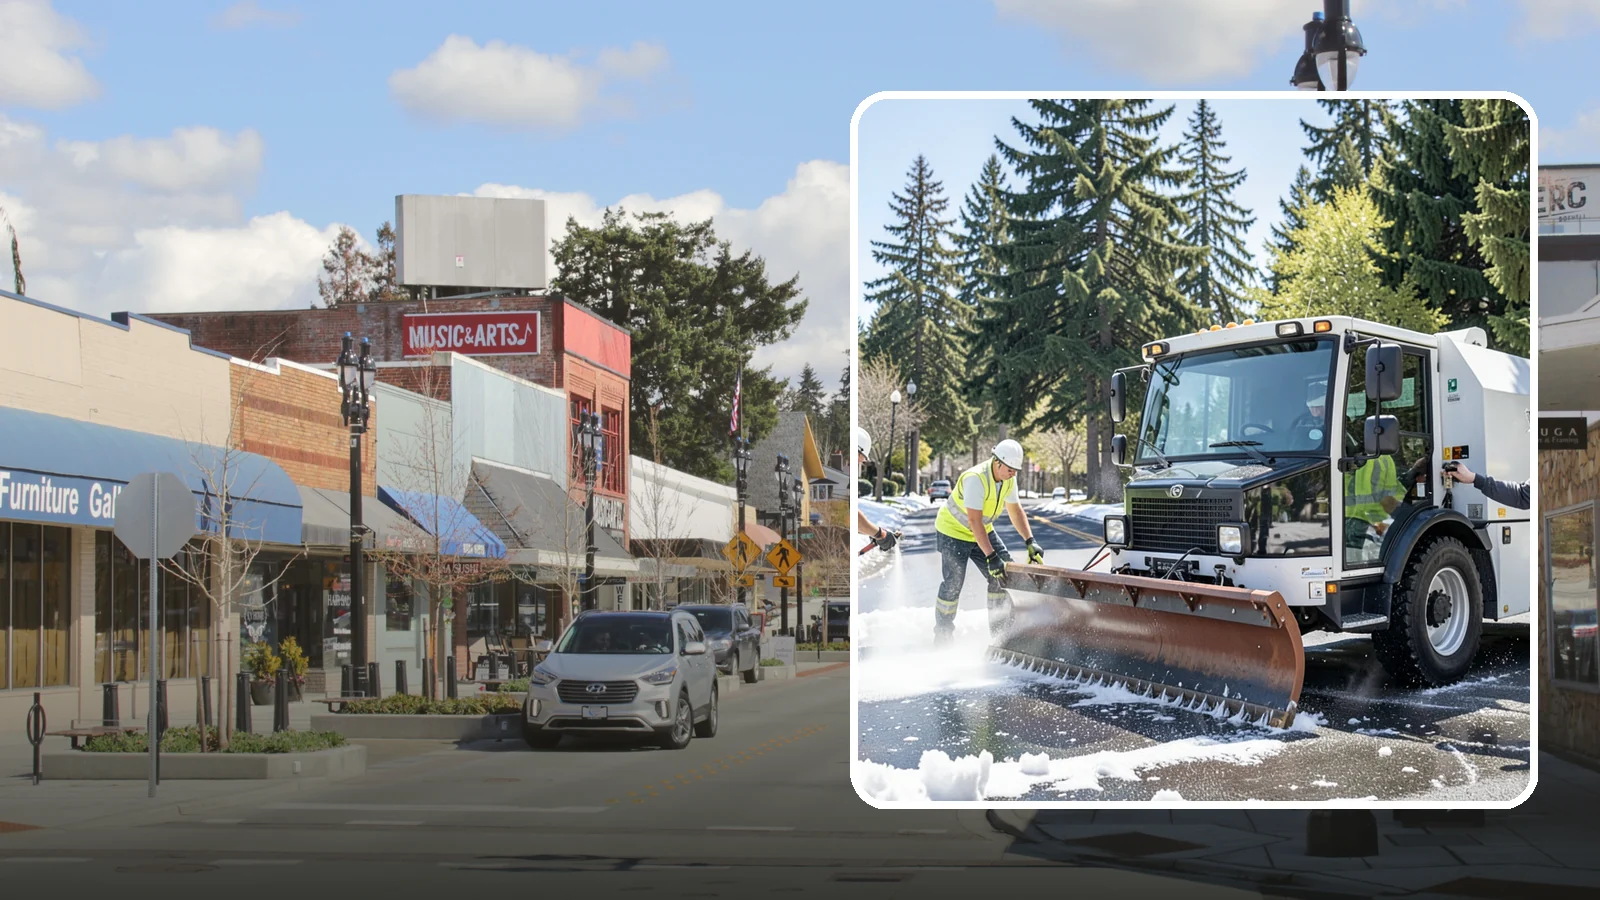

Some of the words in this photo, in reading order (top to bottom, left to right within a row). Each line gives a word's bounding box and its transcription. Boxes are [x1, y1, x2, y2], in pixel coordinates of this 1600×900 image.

[0, 471, 79, 515] Furniture
[89, 482, 122, 519] Gal
[453, 563, 479, 575] SUSHI
